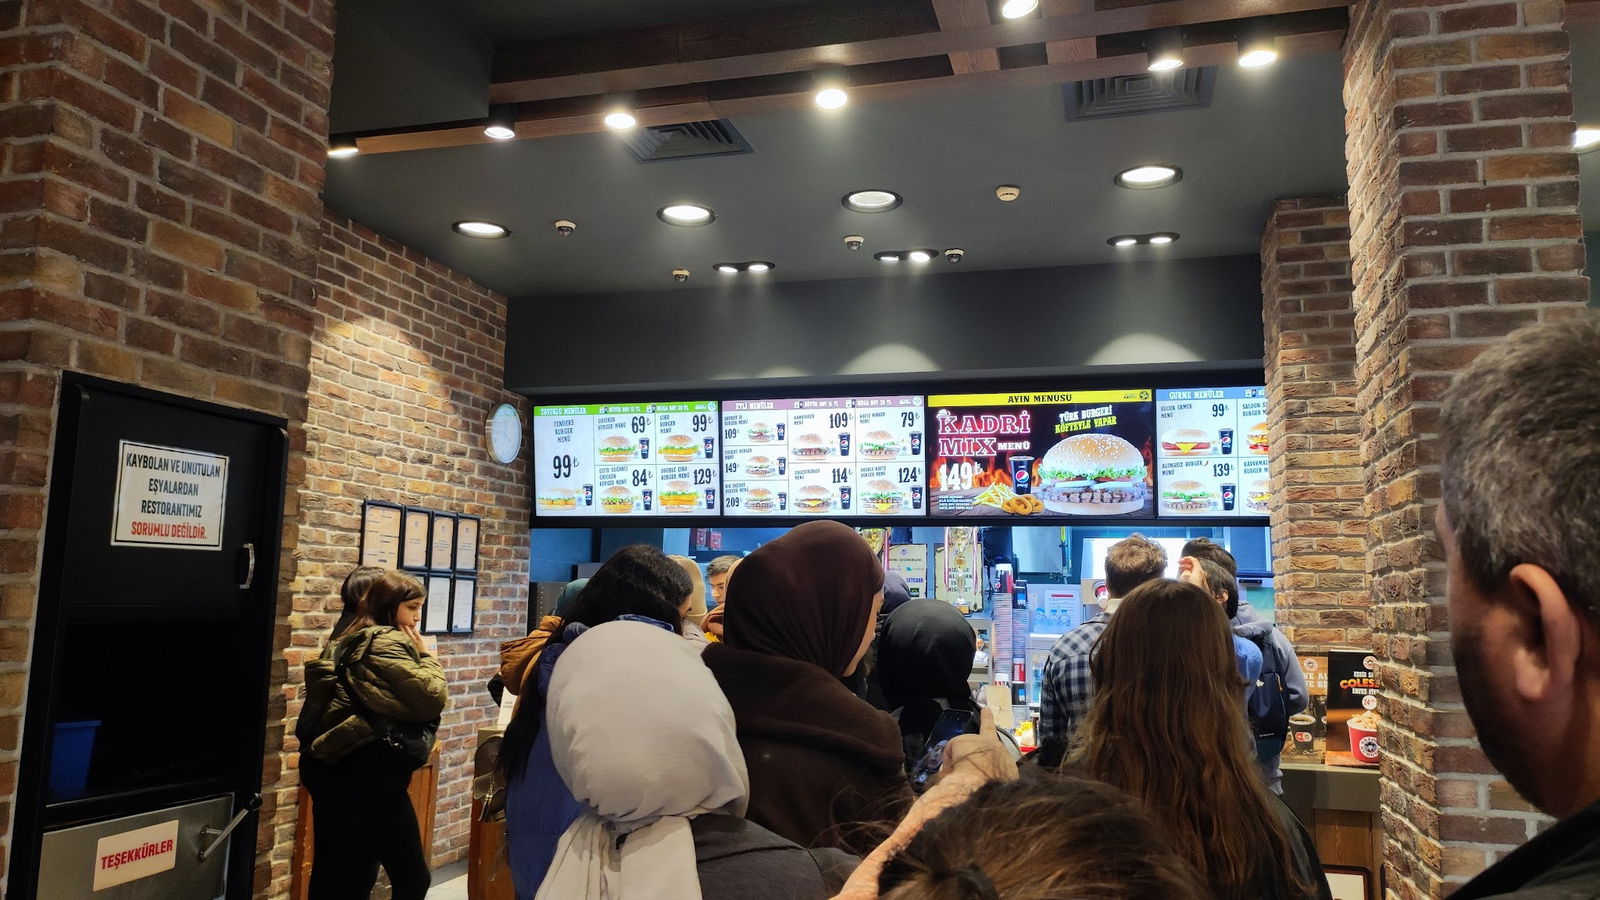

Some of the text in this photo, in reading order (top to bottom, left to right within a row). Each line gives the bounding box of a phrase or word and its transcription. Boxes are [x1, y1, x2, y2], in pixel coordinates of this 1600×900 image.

[1059, 404, 1112, 422] TÜRK BURGERİ
[1055, 416, 1117, 434] KÖFTEYLE YAPAR
[939, 438, 1030, 456] MIX MENÜ
[126, 452, 220, 478] KAYBOLAN VE UNUTULAN
[149, 478, 199, 496] EŞYALARDAN
[141, 500, 202, 518] RESTORANTIMIZ
[131, 521, 207, 539] SORUMLU DEĞİLDİR.
[1340, 678, 1380, 689] COLES
[101, 839, 173, 870] TEŞEKKÜRLER
